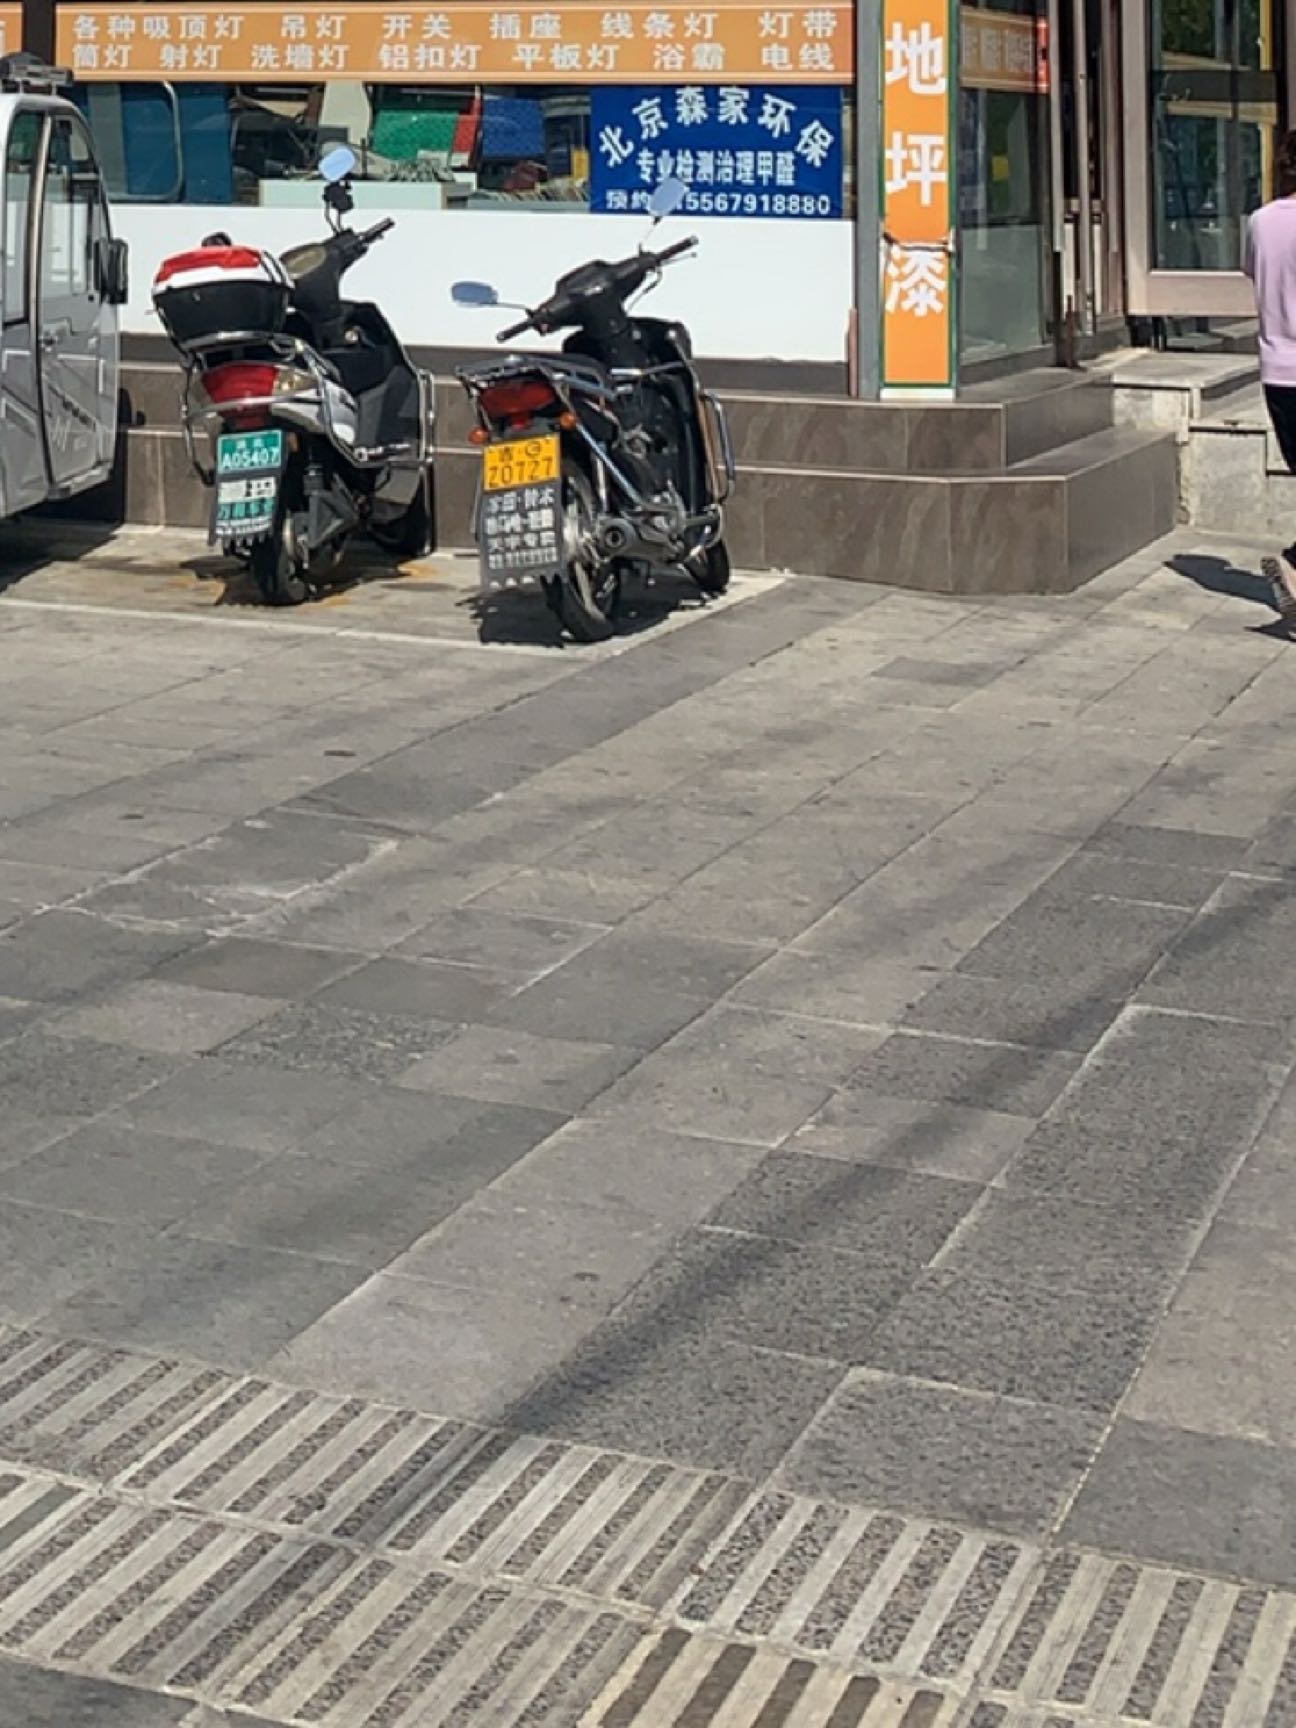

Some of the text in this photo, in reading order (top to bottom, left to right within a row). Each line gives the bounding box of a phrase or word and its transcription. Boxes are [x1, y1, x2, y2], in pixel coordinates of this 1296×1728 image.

[72, 10, 838, 40] 各种吸顶灯 吊灯 开关 插座 线条灯 灯带
[159, 44, 223, 70] 射灯
[250, 44, 351, 71] 洗墙灯
[377, 44, 483, 71] 铝扣灯
[511, 44, 621, 71] 平板灯
[652, 43, 725, 71] 浴霸
[760, 43, 836, 71] 电线
[598, 85, 835, 168] 北京森家环保
[884, 22, 949, 318] 地坪漆
